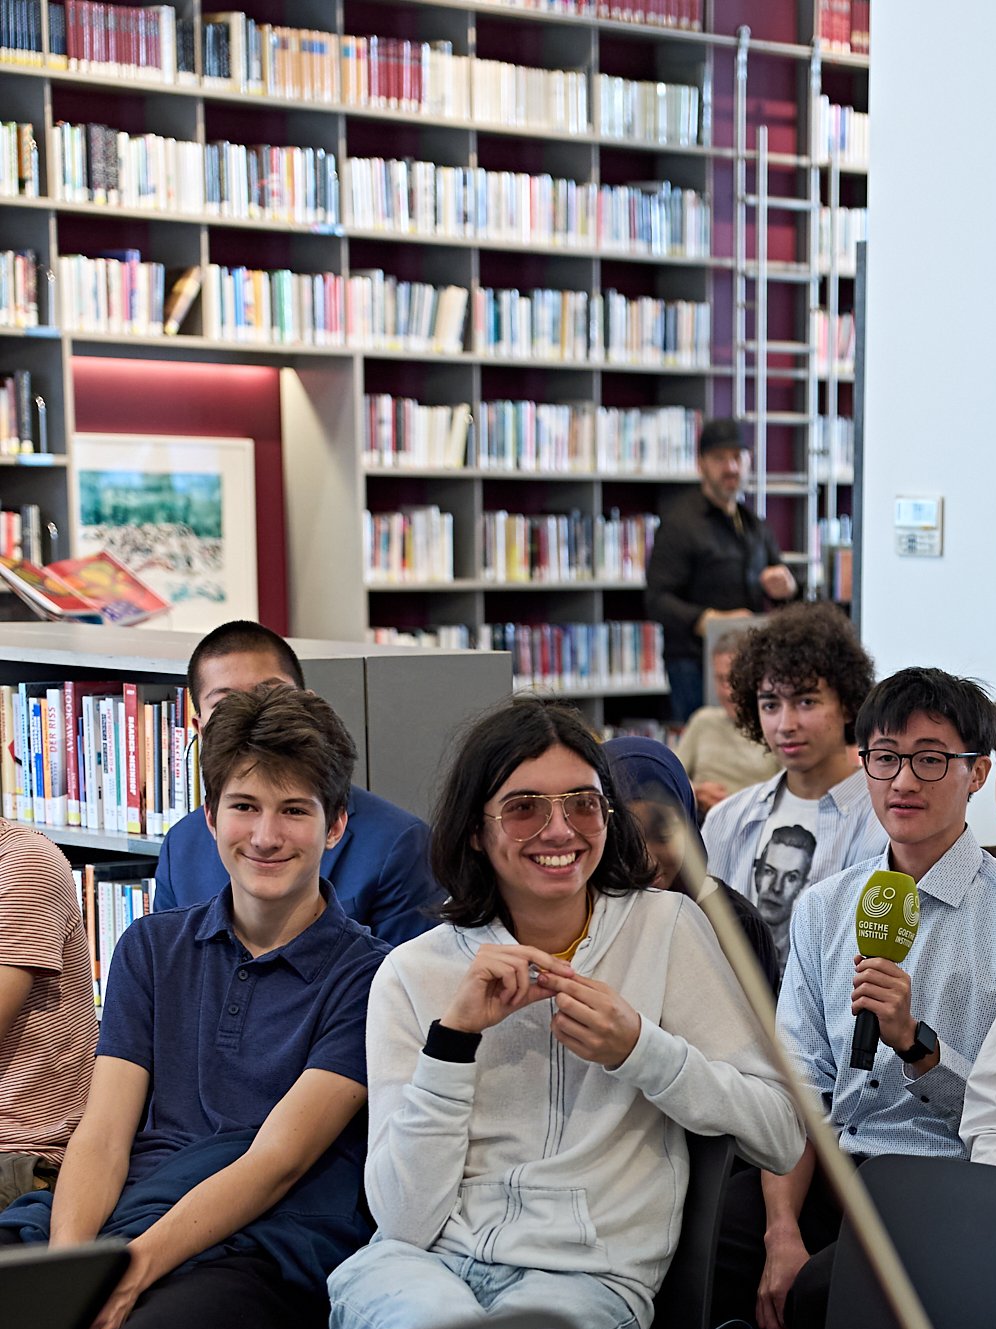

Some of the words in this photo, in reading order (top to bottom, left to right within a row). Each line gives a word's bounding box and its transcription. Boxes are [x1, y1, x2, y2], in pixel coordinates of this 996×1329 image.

[65, 688, 73, 720] LOOK
[48, 706, 56, 730] RISS
[49, 731, 58, 753] DER
[66, 719, 74, 753] AWAY
[128, 716, 137, 796] BAADER-MEINHOF
[858, 920, 889, 932] GOETHE
[858, 929, 888, 941] INSTITUT
